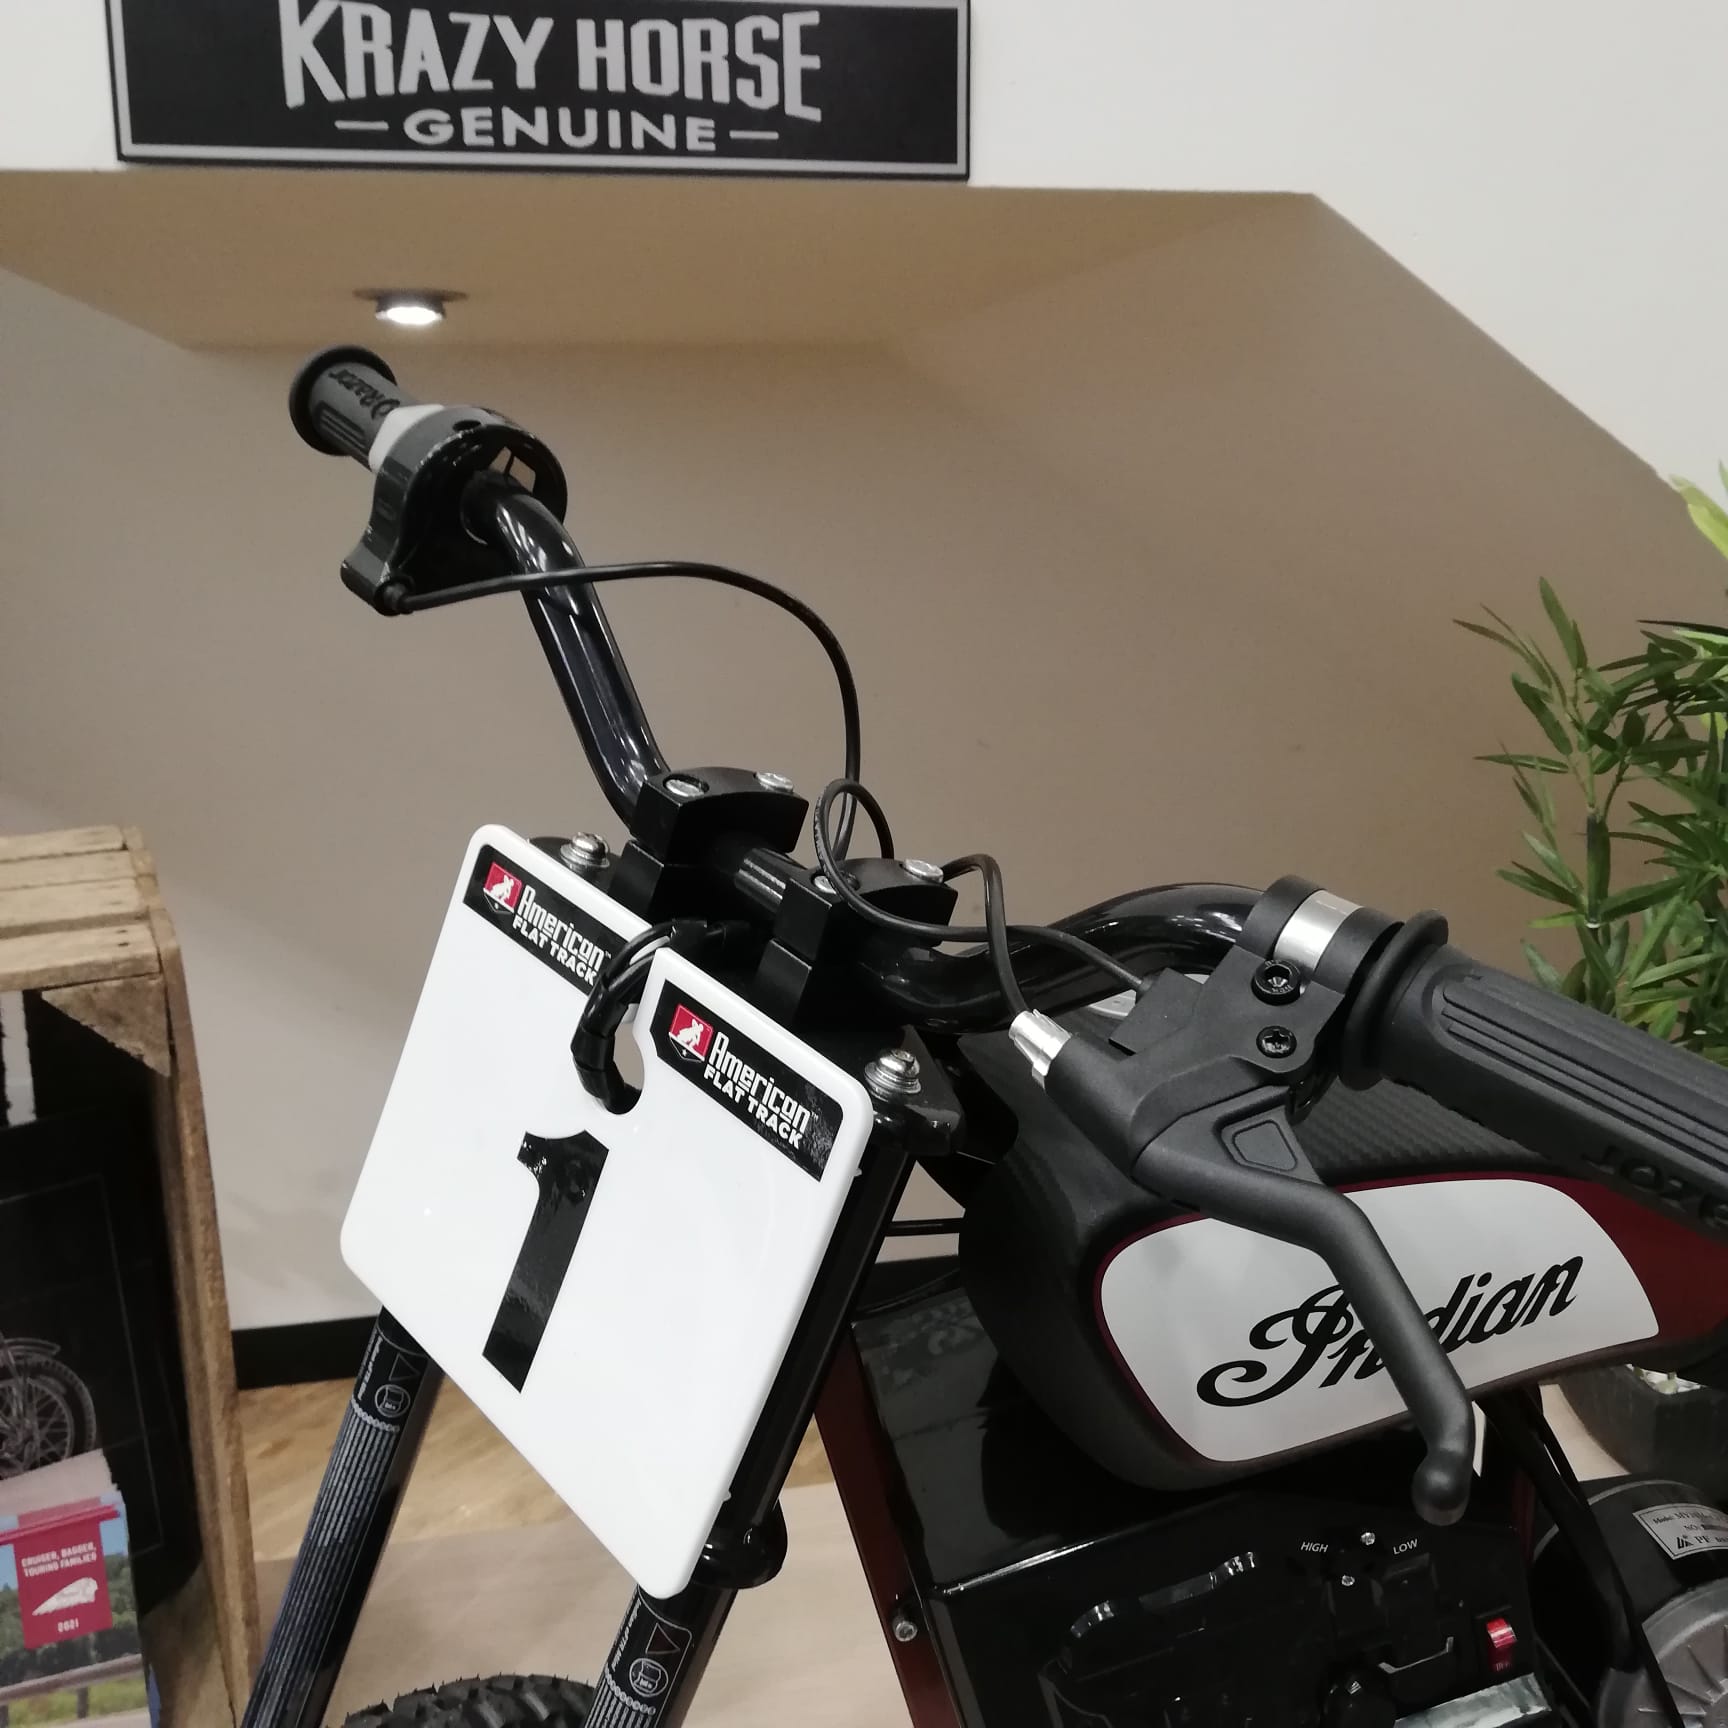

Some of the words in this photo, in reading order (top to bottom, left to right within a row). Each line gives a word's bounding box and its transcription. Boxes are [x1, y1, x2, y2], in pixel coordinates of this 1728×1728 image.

[278, 0, 554, 109] KRAZY
[576, 10, 822, 122] HORSE
[403, 105, 716, 151] GENUINE
[512, 914, 548, 949] FLAT
[550, 940, 597, 986] TRACK
[703, 1063, 745, 1103] FLAT
[747, 1095, 803, 1149] TRACK
[482, 1129, 610, 1394] 1
[1300, 1541, 1329, 1553] HIGH
[1392, 1538, 1418, 1555] LOW
